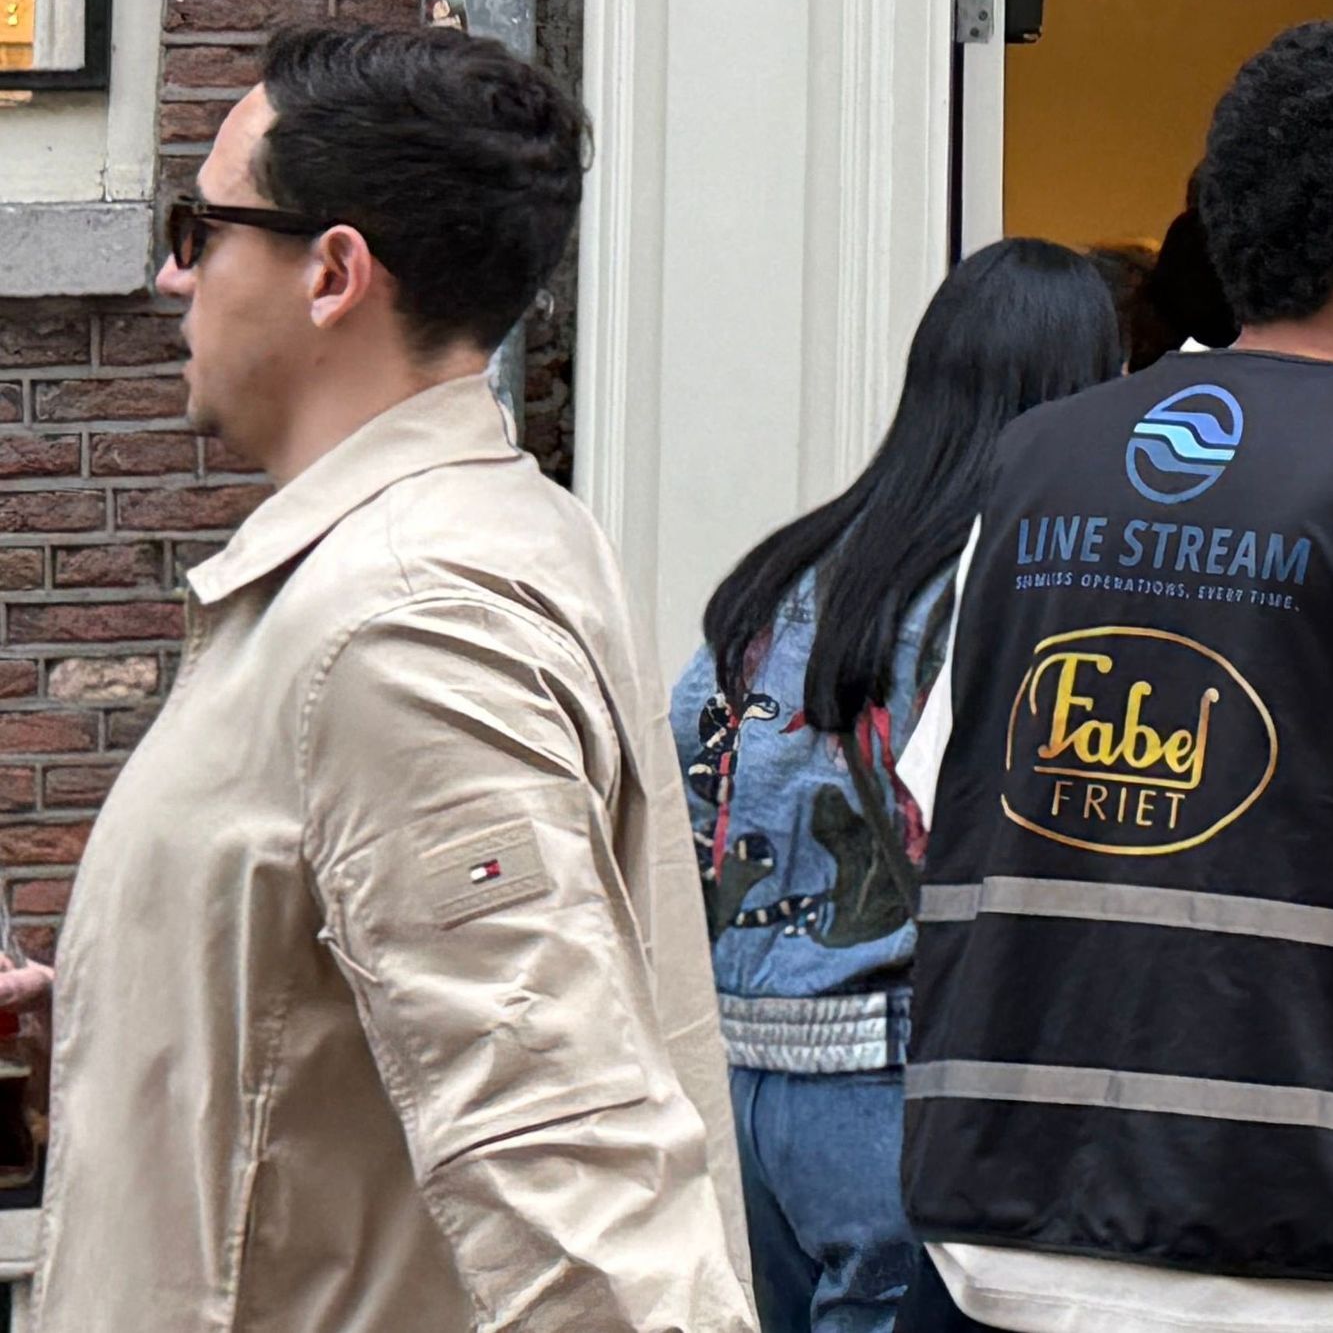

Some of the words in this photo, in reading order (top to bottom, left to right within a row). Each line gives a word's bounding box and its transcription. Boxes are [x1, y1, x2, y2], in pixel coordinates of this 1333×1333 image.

[1016, 515, 1109, 565] LINE
[1117, 519, 1312, 585] STREAM
[1029, 652, 1220, 789] Fabel
[1050, 780, 1187, 830] FRIET
